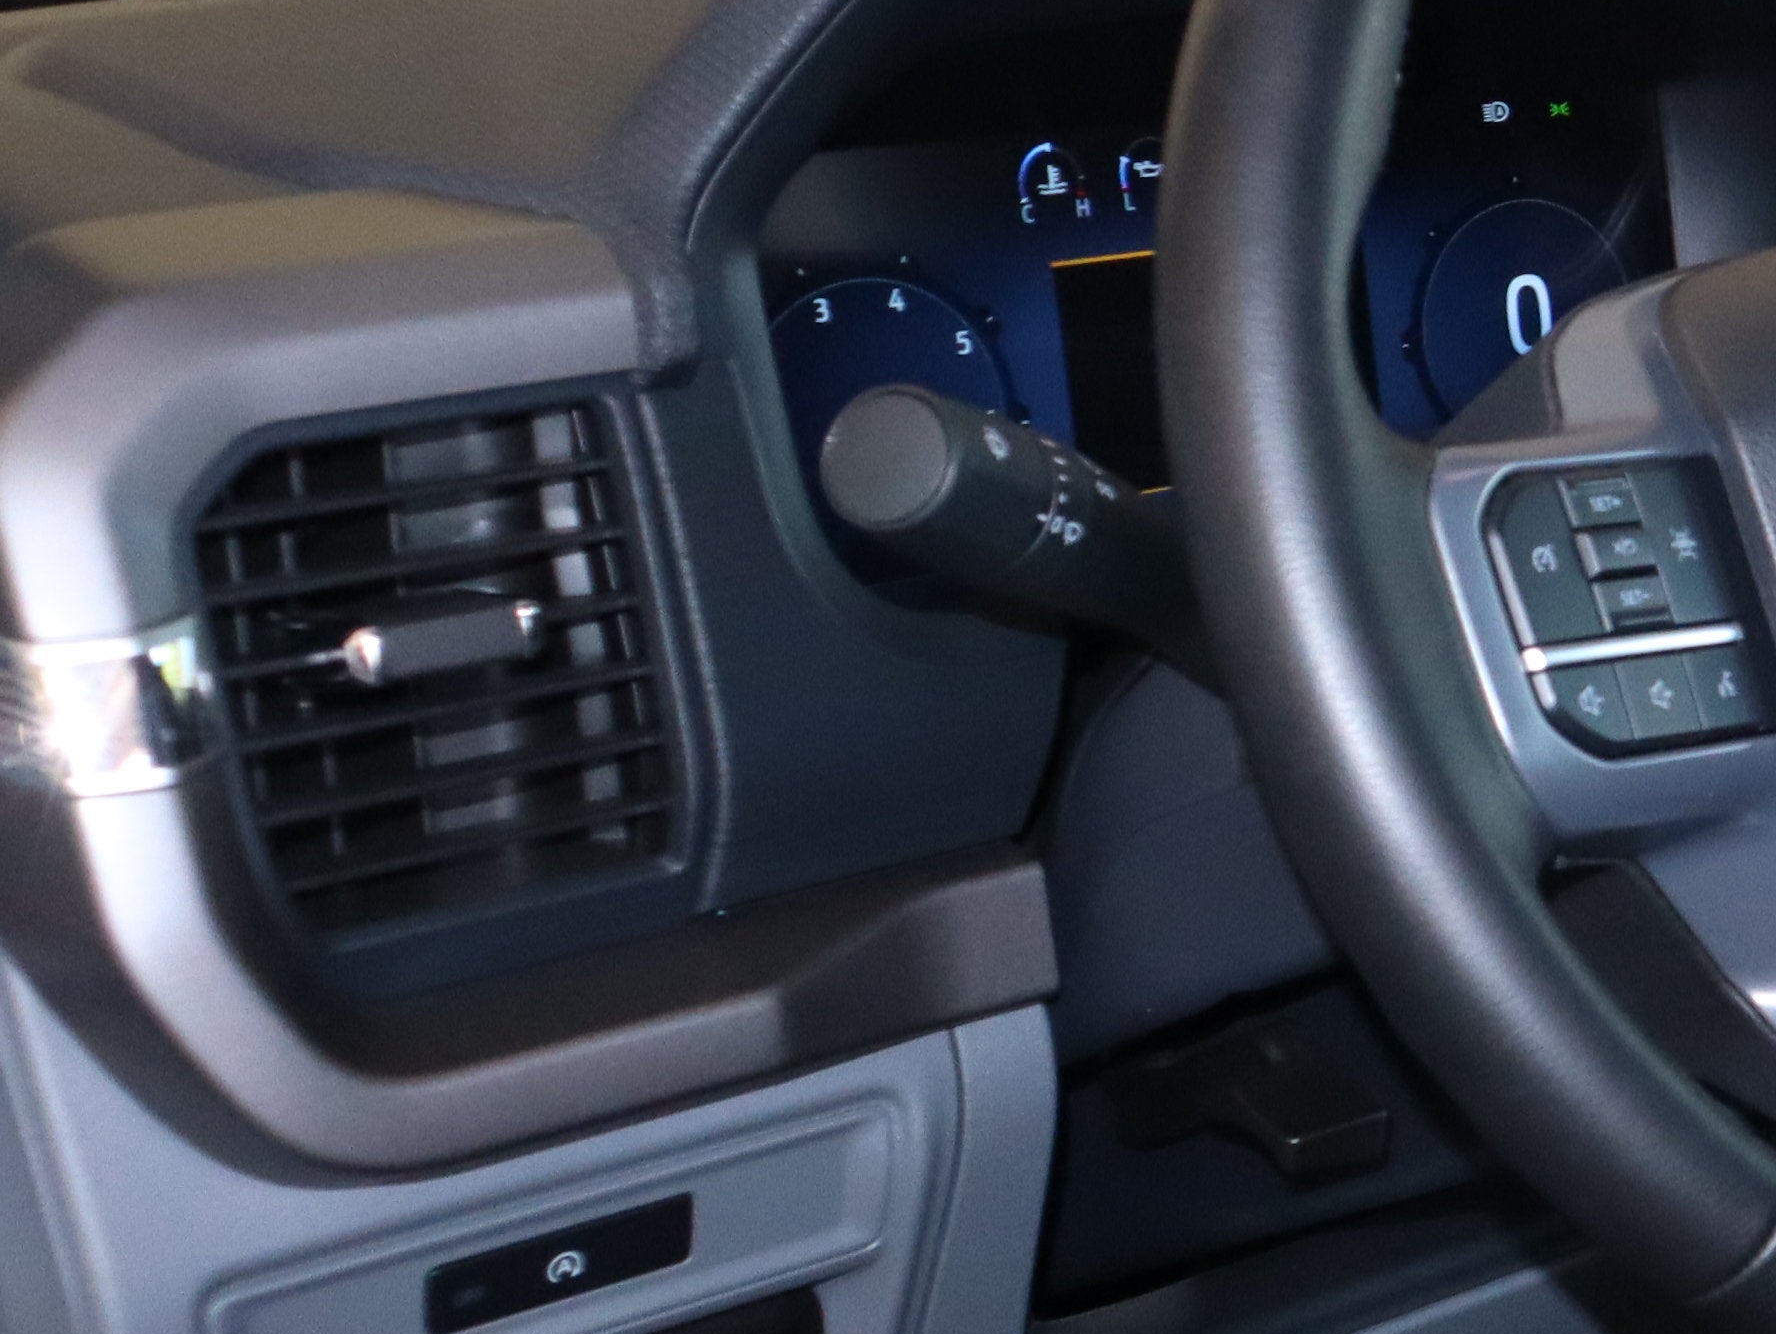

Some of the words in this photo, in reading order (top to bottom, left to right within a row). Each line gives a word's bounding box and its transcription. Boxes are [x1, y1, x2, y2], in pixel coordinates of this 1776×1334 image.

[1020, 204, 1035, 223] C
[1075, 198, 1092, 217] H
[1123, 192, 1137, 211] L
[812, 297, 831, 324] 3
[888, 288, 906, 312] 4
[1506, 273, 1554, 355] 0
[955, 329, 974, 356] 5
